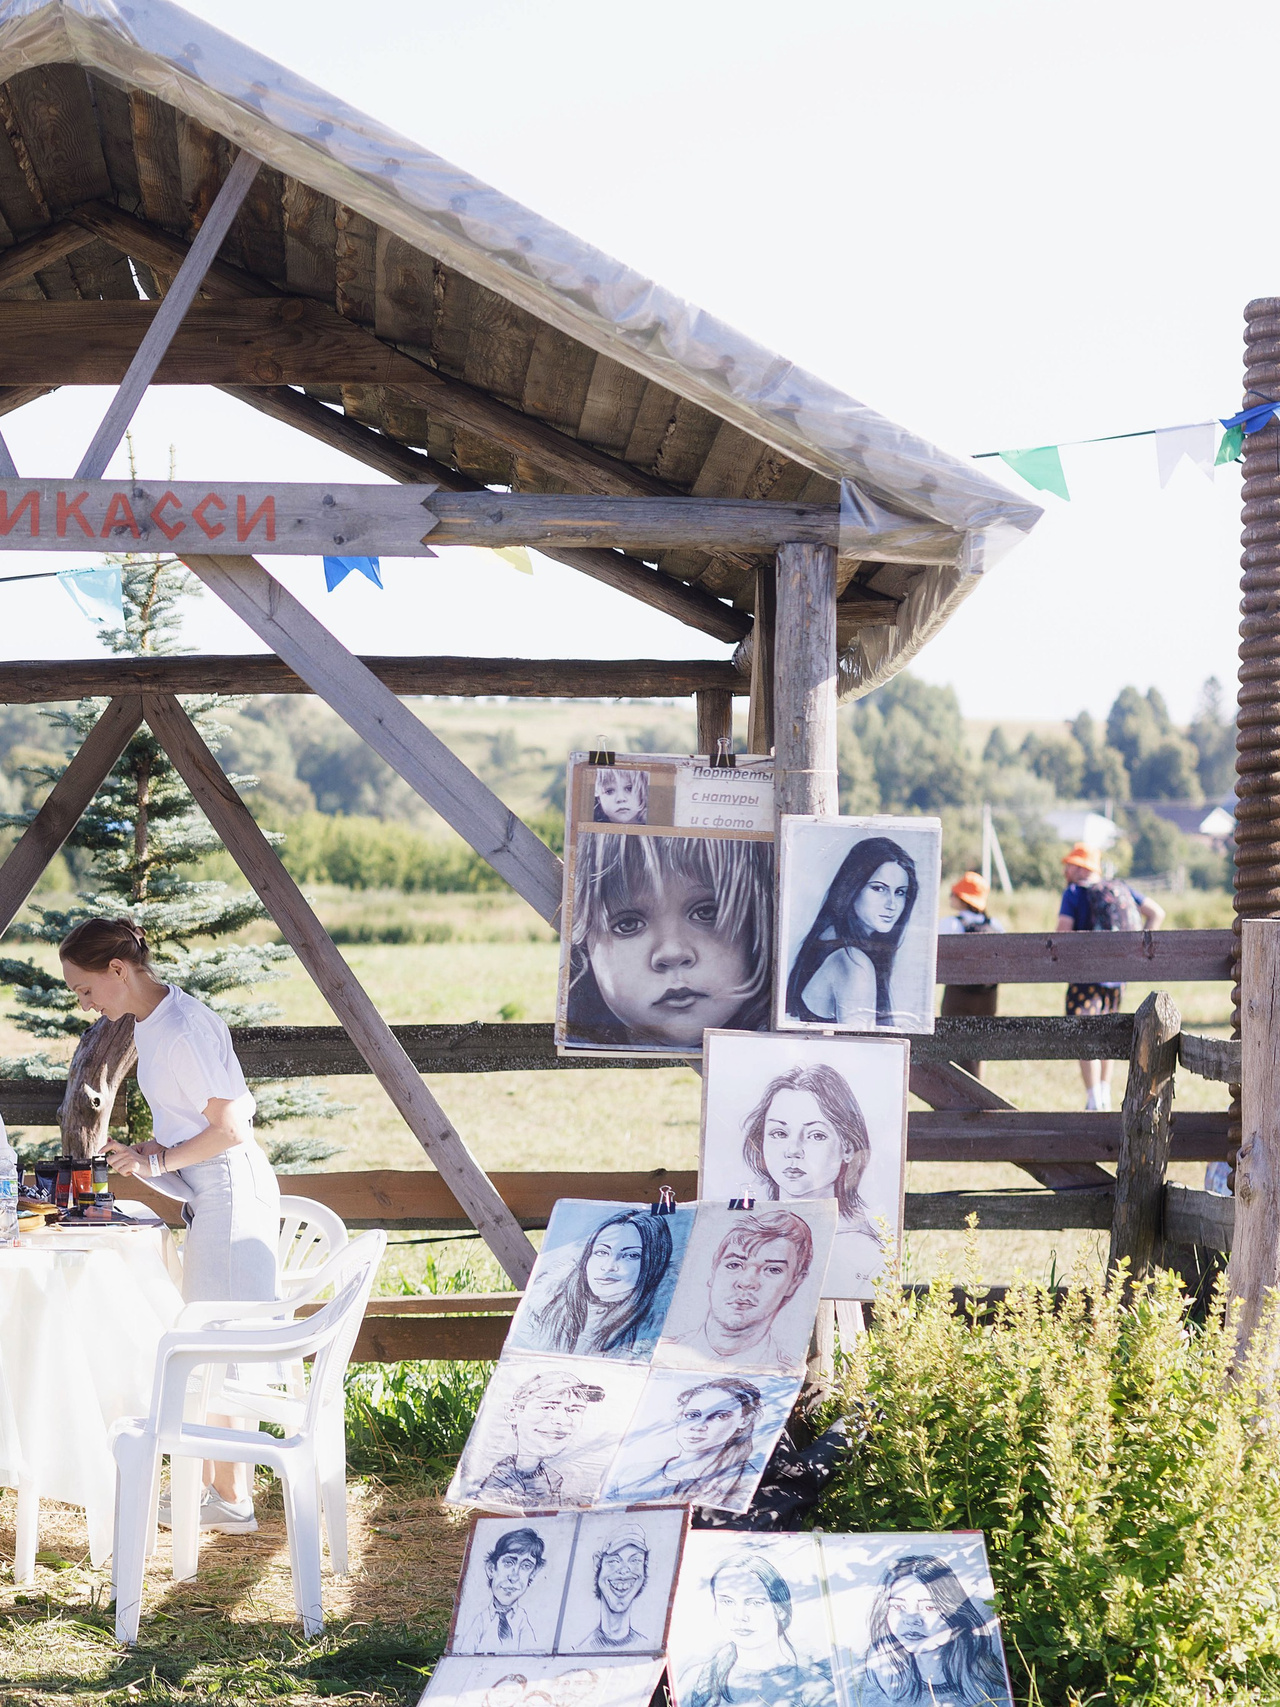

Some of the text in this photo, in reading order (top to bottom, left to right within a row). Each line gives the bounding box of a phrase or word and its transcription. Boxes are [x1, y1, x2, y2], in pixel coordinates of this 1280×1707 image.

[693, 766, 774, 781] Портреты
[702, 793, 759, 805] натуры
[713, 814, 754, 829] фото
